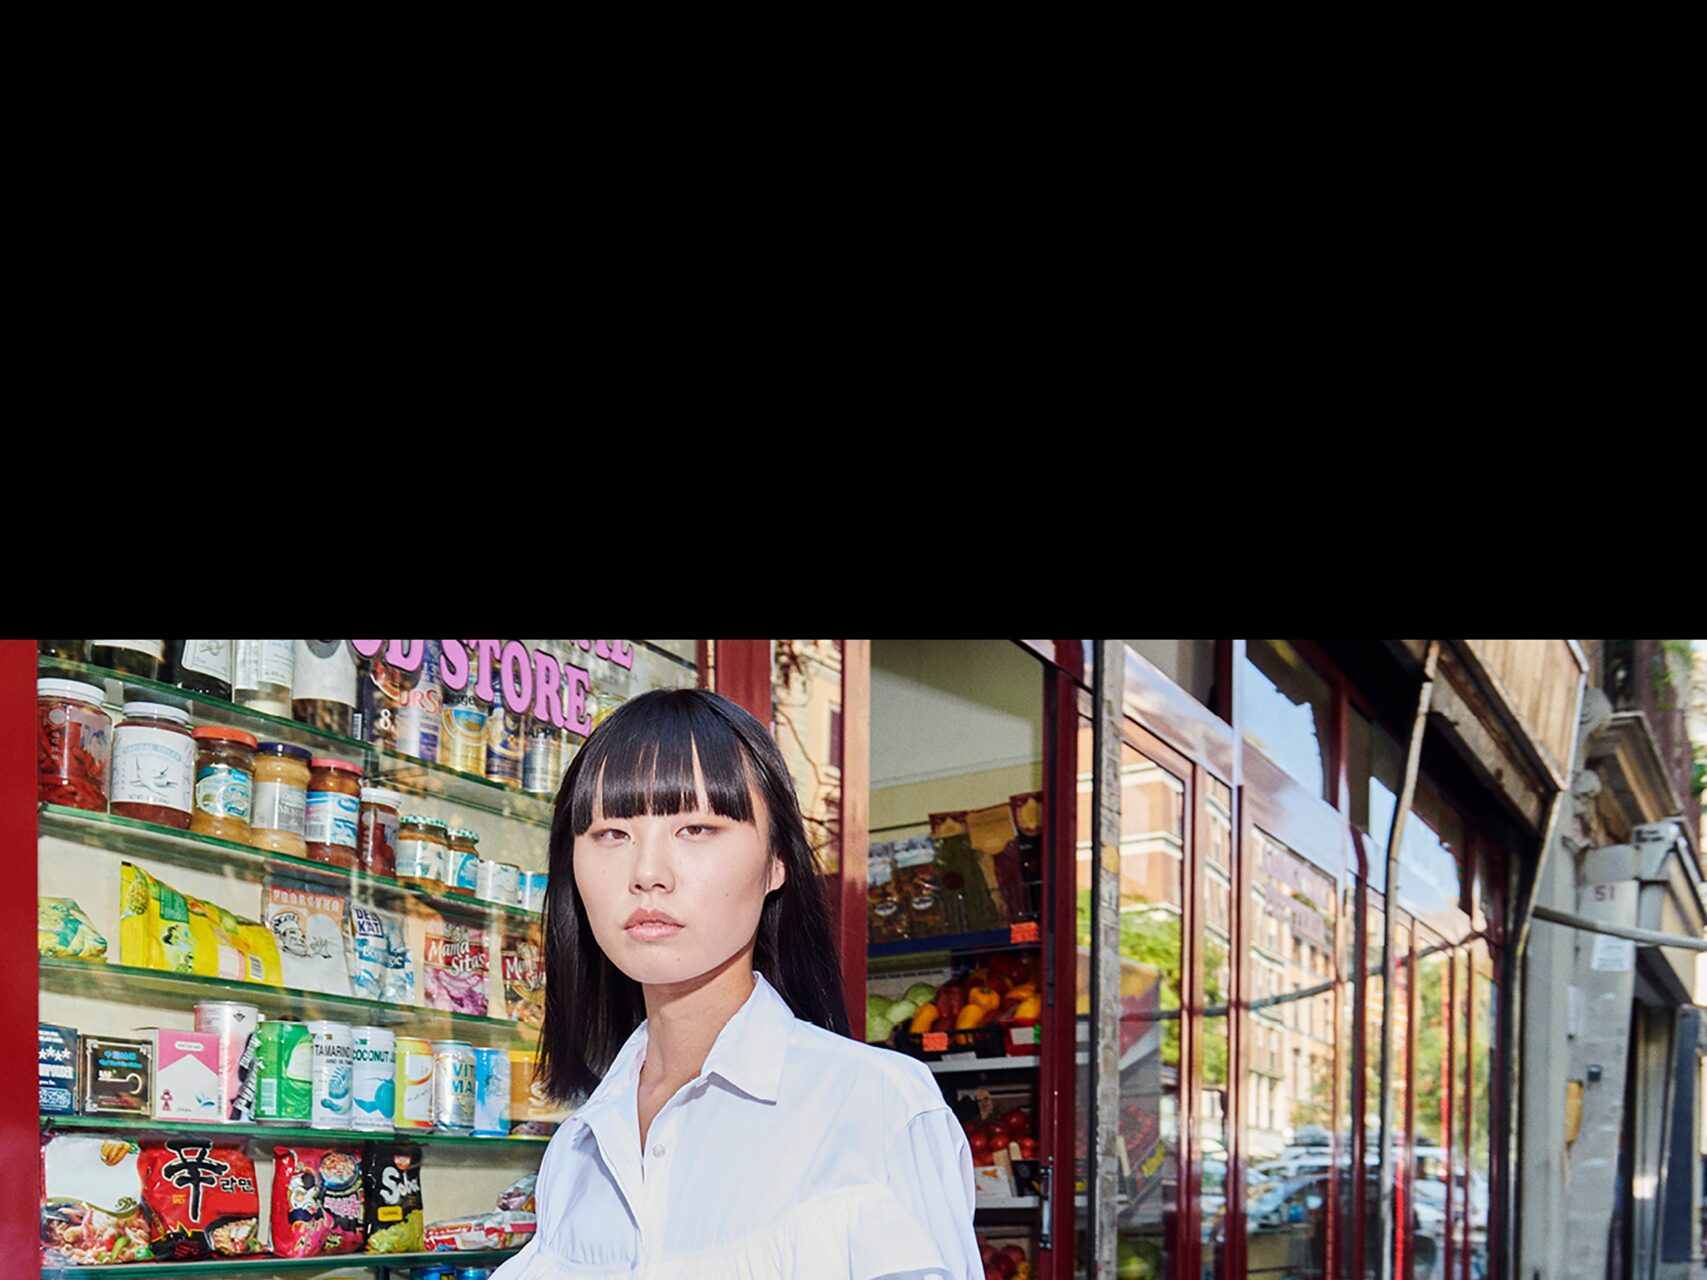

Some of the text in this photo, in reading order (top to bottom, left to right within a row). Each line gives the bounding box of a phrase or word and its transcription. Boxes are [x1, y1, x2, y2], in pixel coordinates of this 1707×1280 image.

[439, 640, 593, 738] STORE
[1594, 884, 1616, 901] 51
[429, 940, 470, 964] Mama
[163, 1138, 229, 1223] 辛
[220, 1176, 255, 1194] 라면
[380, 1166, 419, 1204] Soba
